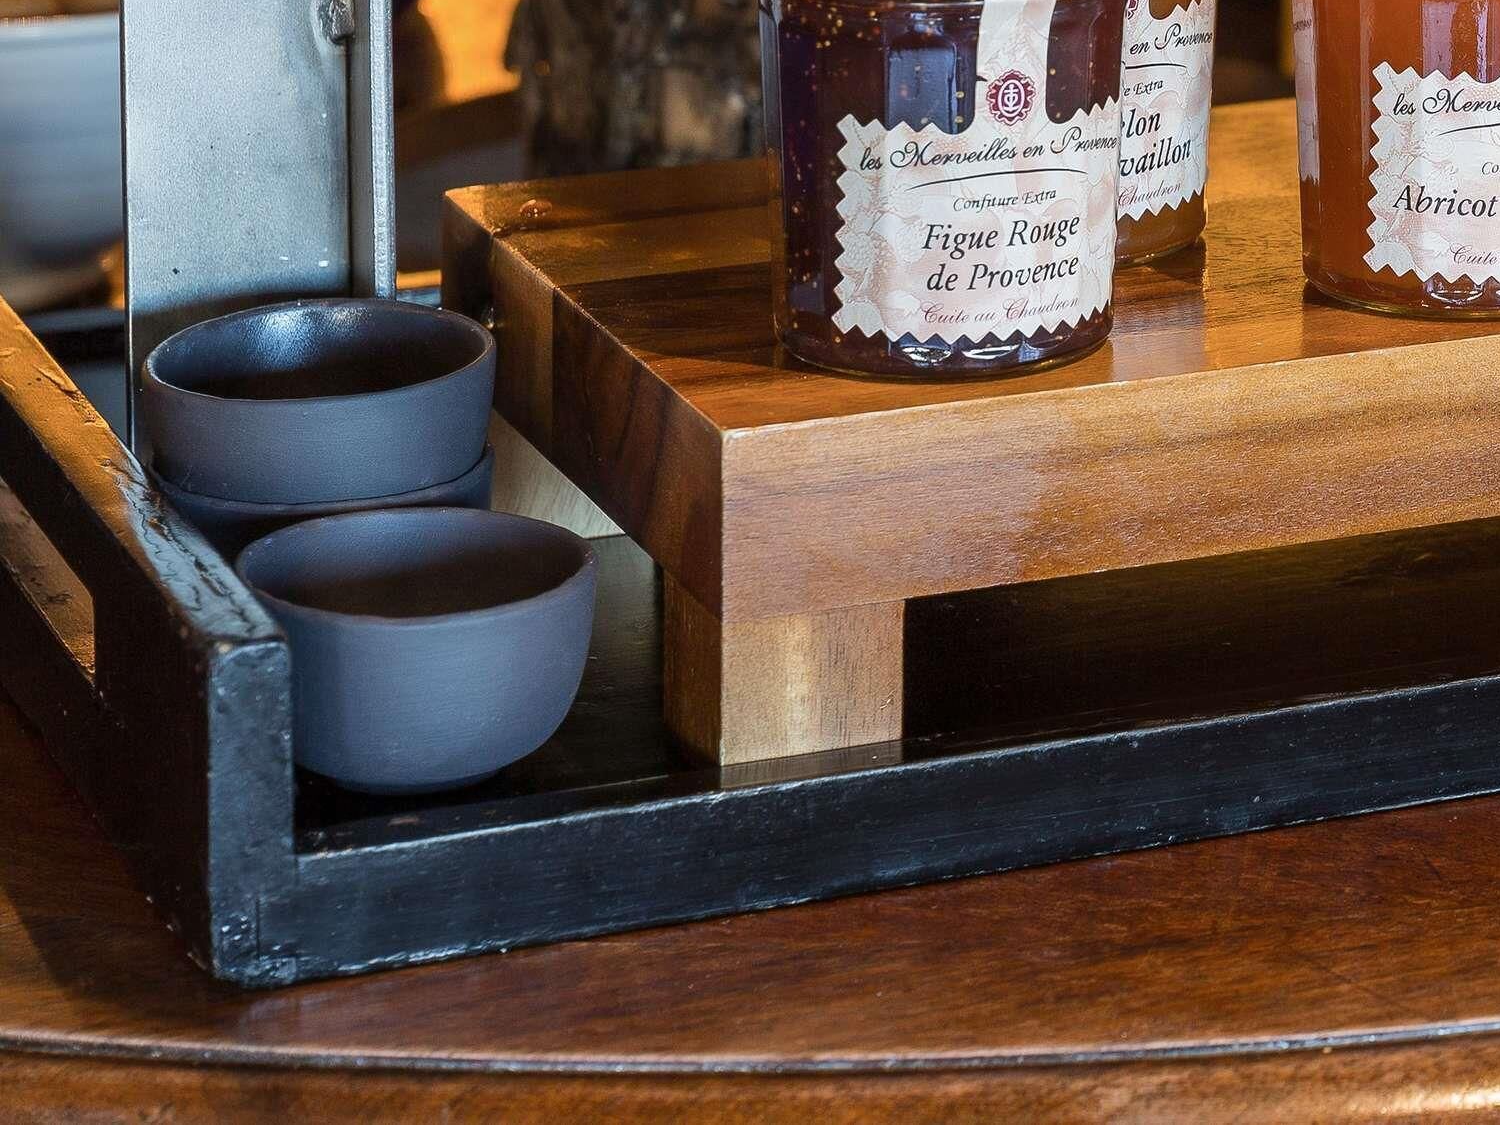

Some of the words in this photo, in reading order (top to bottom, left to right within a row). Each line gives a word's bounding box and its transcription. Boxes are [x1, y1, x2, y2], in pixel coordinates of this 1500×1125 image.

[1130, 40, 1151, 55] en
[1154, 23, 1213, 50] Provence
[1133, 79, 1164, 96] Extra
[1393, 92, 1416, 116] les
[860, 147, 884, 173] les
[889, 137, 1017, 169] Merveilles
[1022, 143, 1044, 160] en
[1050, 125, 1119, 156] Provence
[953, 192, 1020, 213] Confiture
[1022, 187, 1057, 207] Extra
[1392, 183, 1499, 219] Abricot
[922, 222, 999, 261] Figue
[1006, 214, 1080, 252] Rouge
[926, 263, 959, 293] de
[968, 254, 1080, 291] Provence
[921, 302, 970, 326] Cuite
[973, 310, 999, 326] au
[1000, 292, 1080, 320] Chaudron
